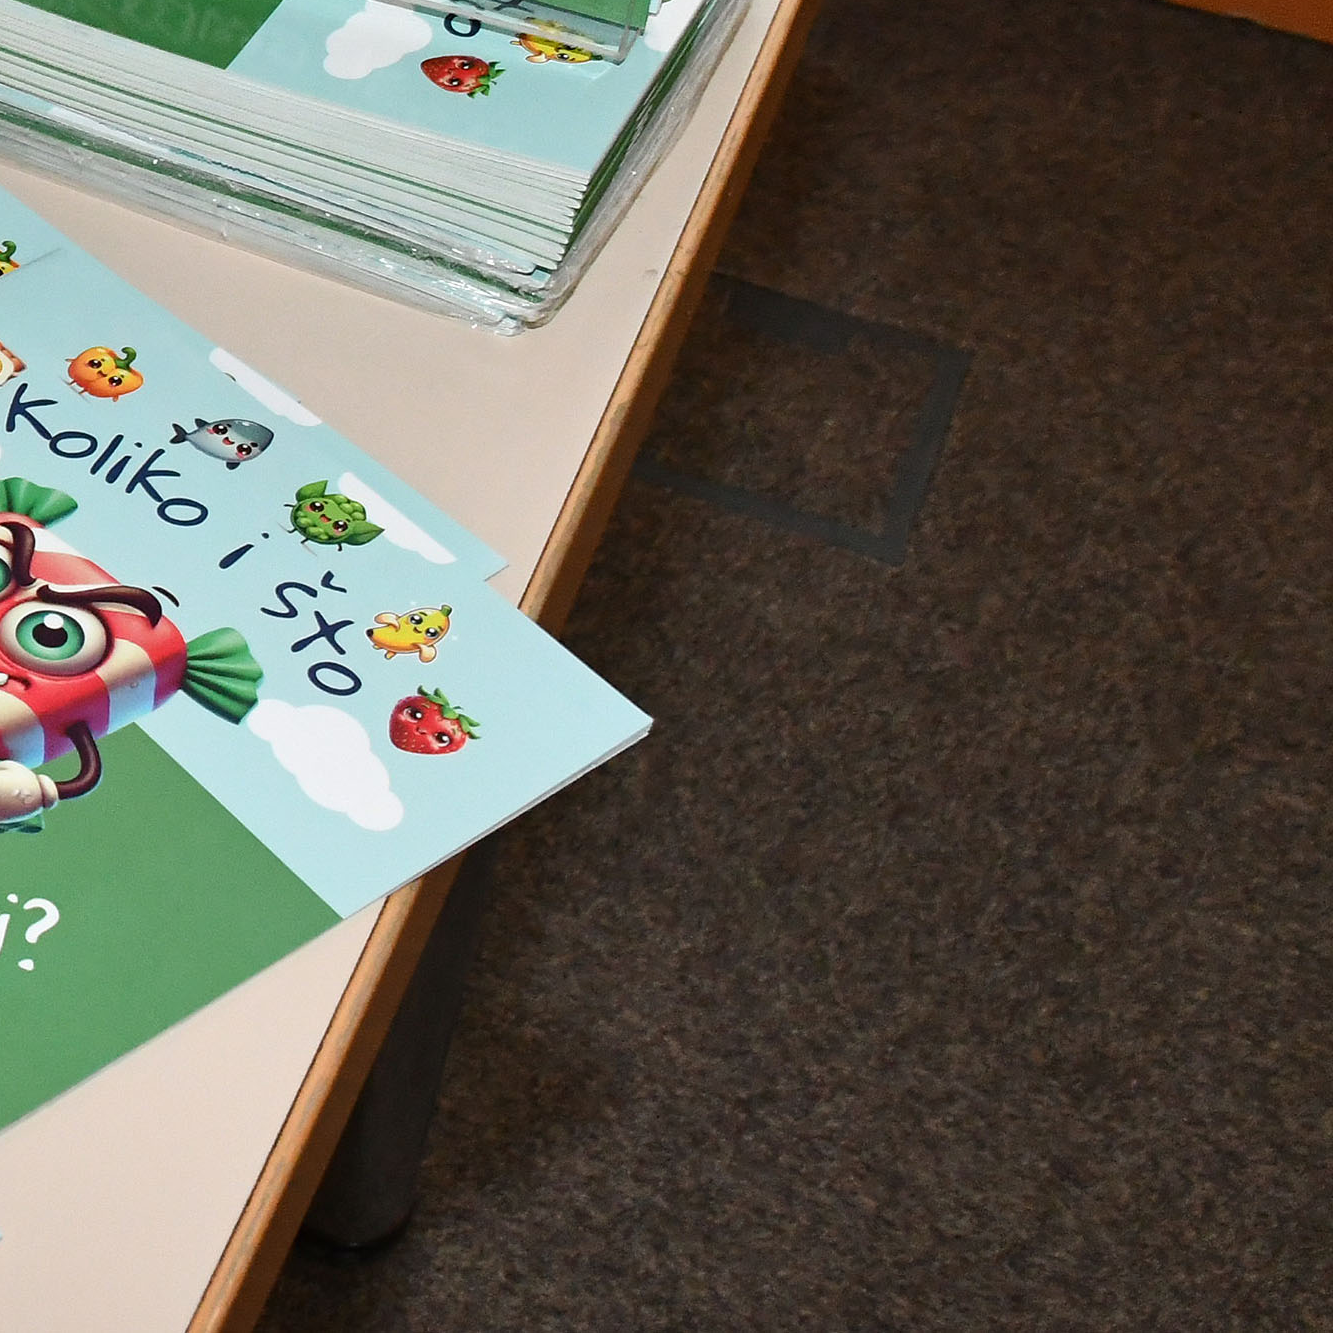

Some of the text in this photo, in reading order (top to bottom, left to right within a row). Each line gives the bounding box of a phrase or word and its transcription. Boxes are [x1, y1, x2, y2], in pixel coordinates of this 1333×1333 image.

[3, 382, 363, 698] Koliko i Što
